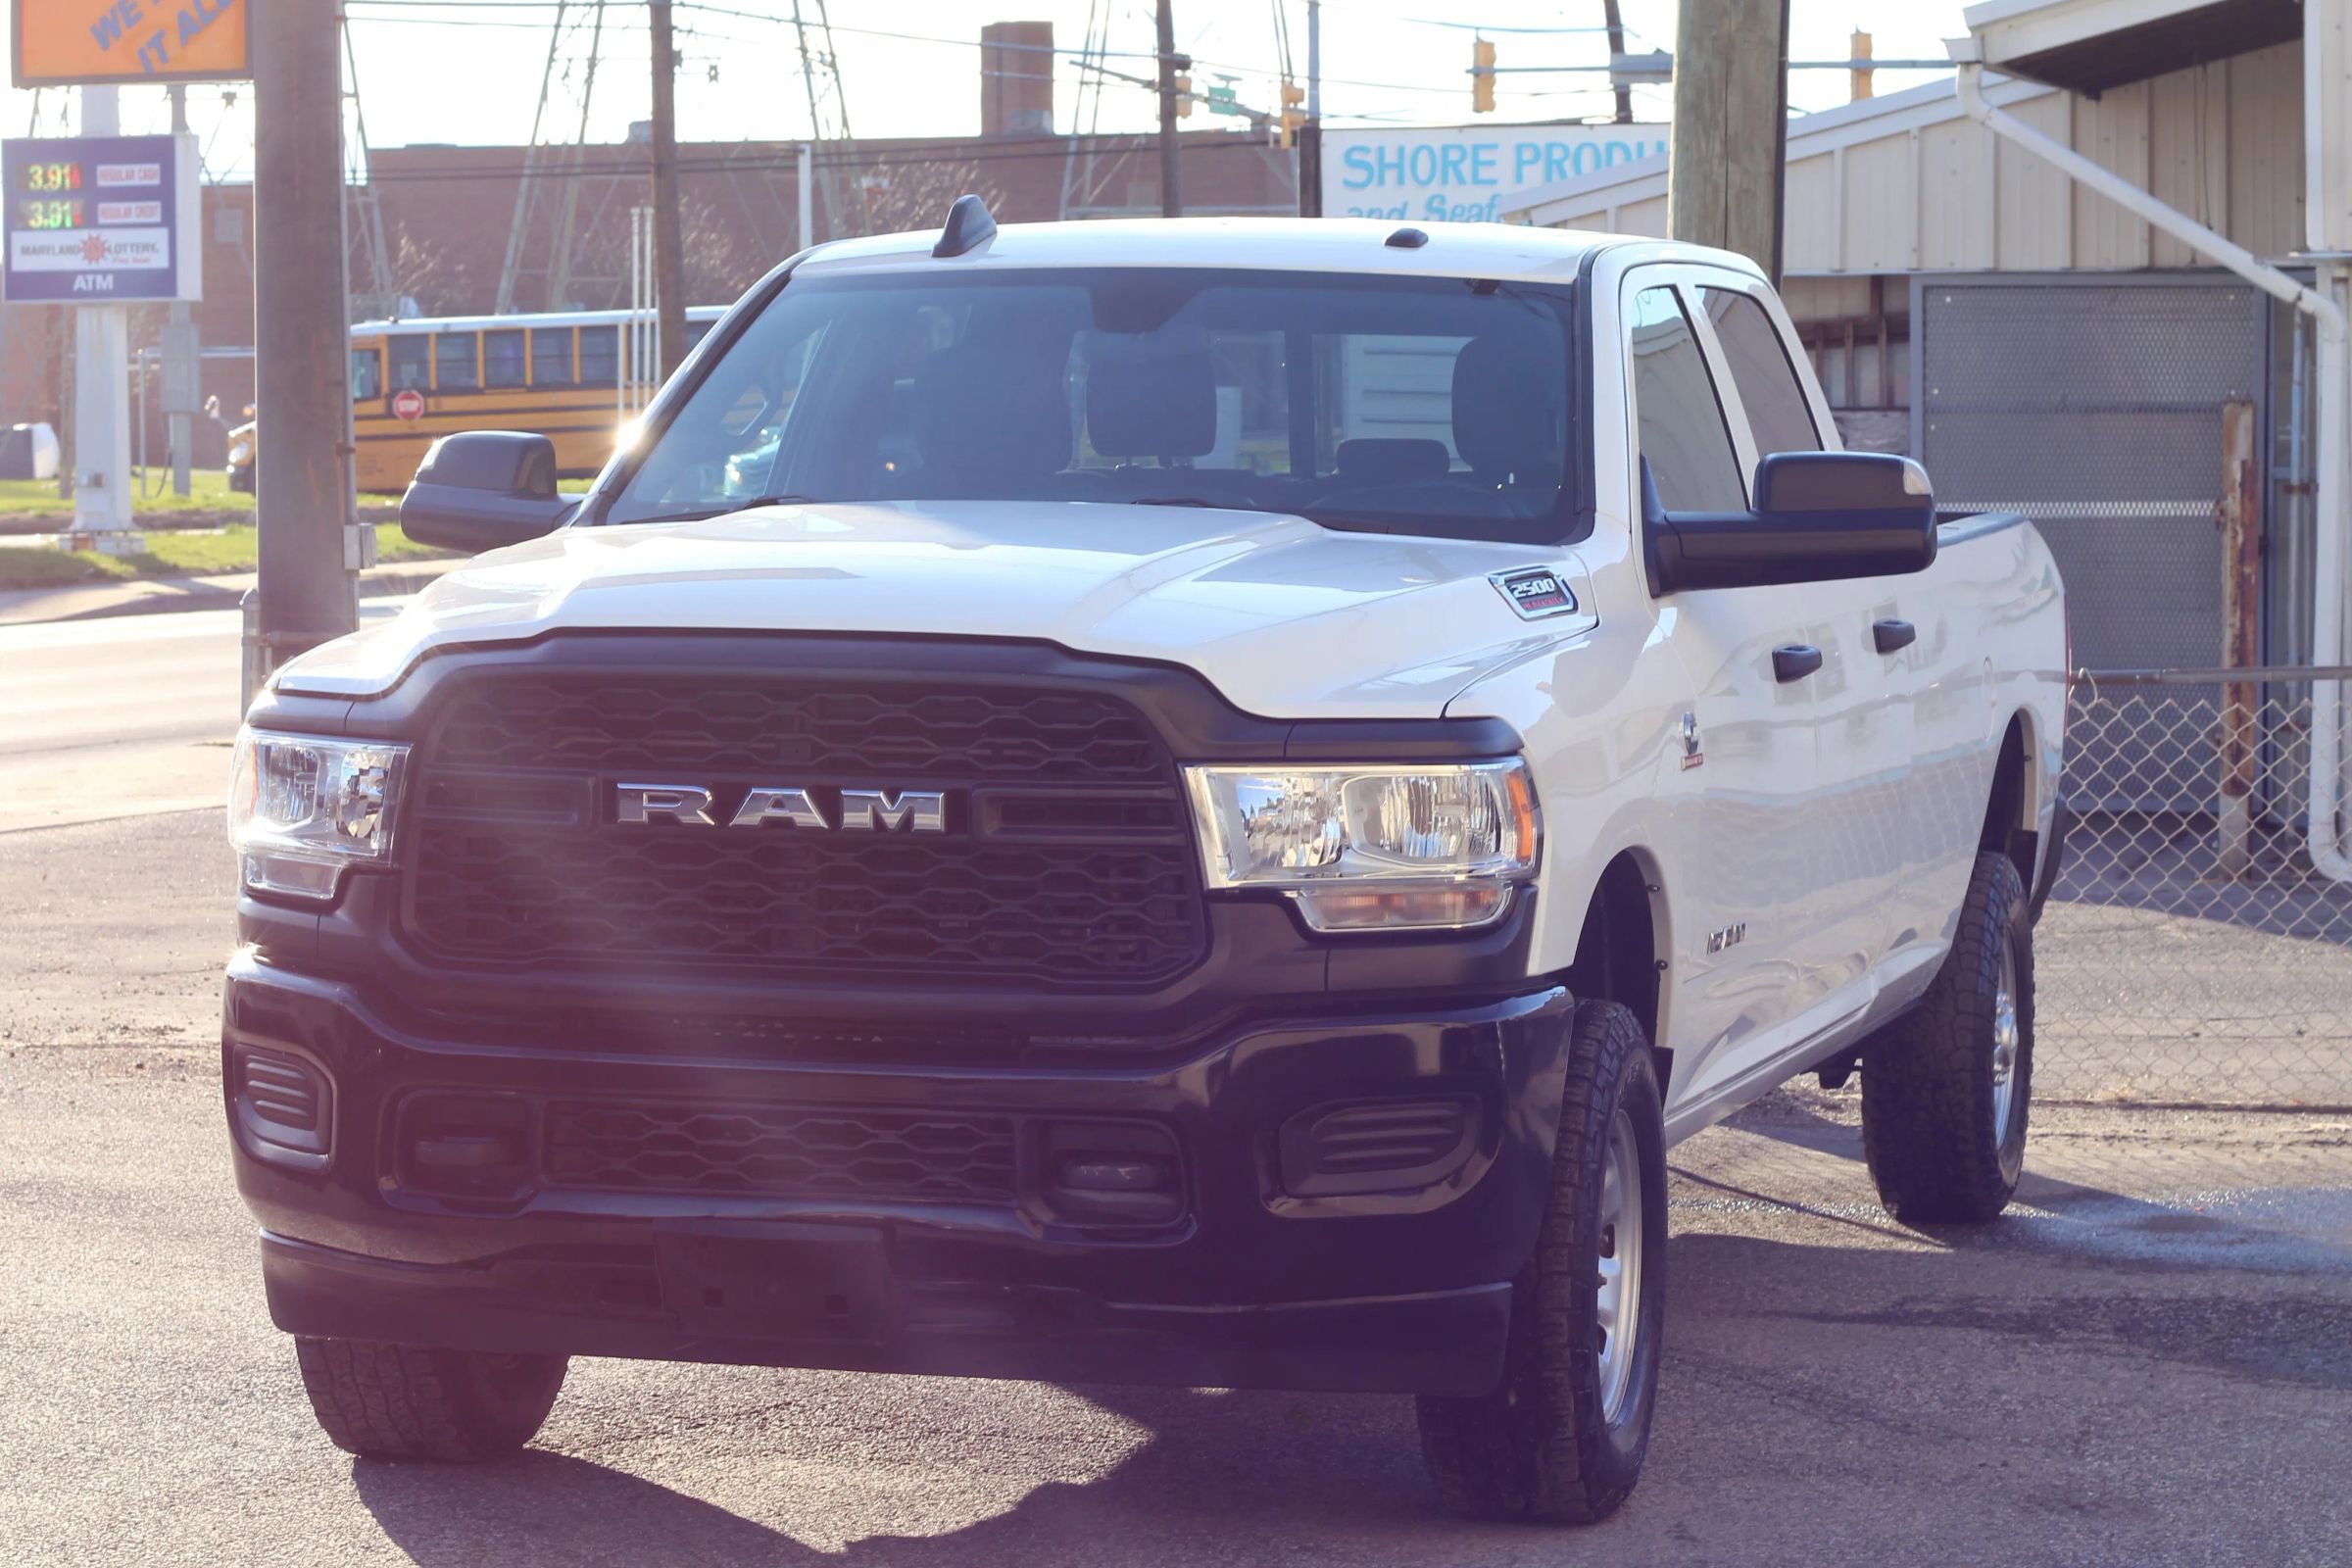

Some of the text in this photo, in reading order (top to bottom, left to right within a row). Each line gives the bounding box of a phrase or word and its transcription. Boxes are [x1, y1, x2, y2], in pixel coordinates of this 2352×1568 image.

[90, 0, 143, 50] WE
[137, 29, 169, 74] IT
[1342, 143, 1499, 188] SHORE
[1423, 193, 1509, 223] Seaf
[73, 273, 115, 292] ATM
[1509, 577, 1556, 598] 2500
[617, 782, 946, 832] RAM
